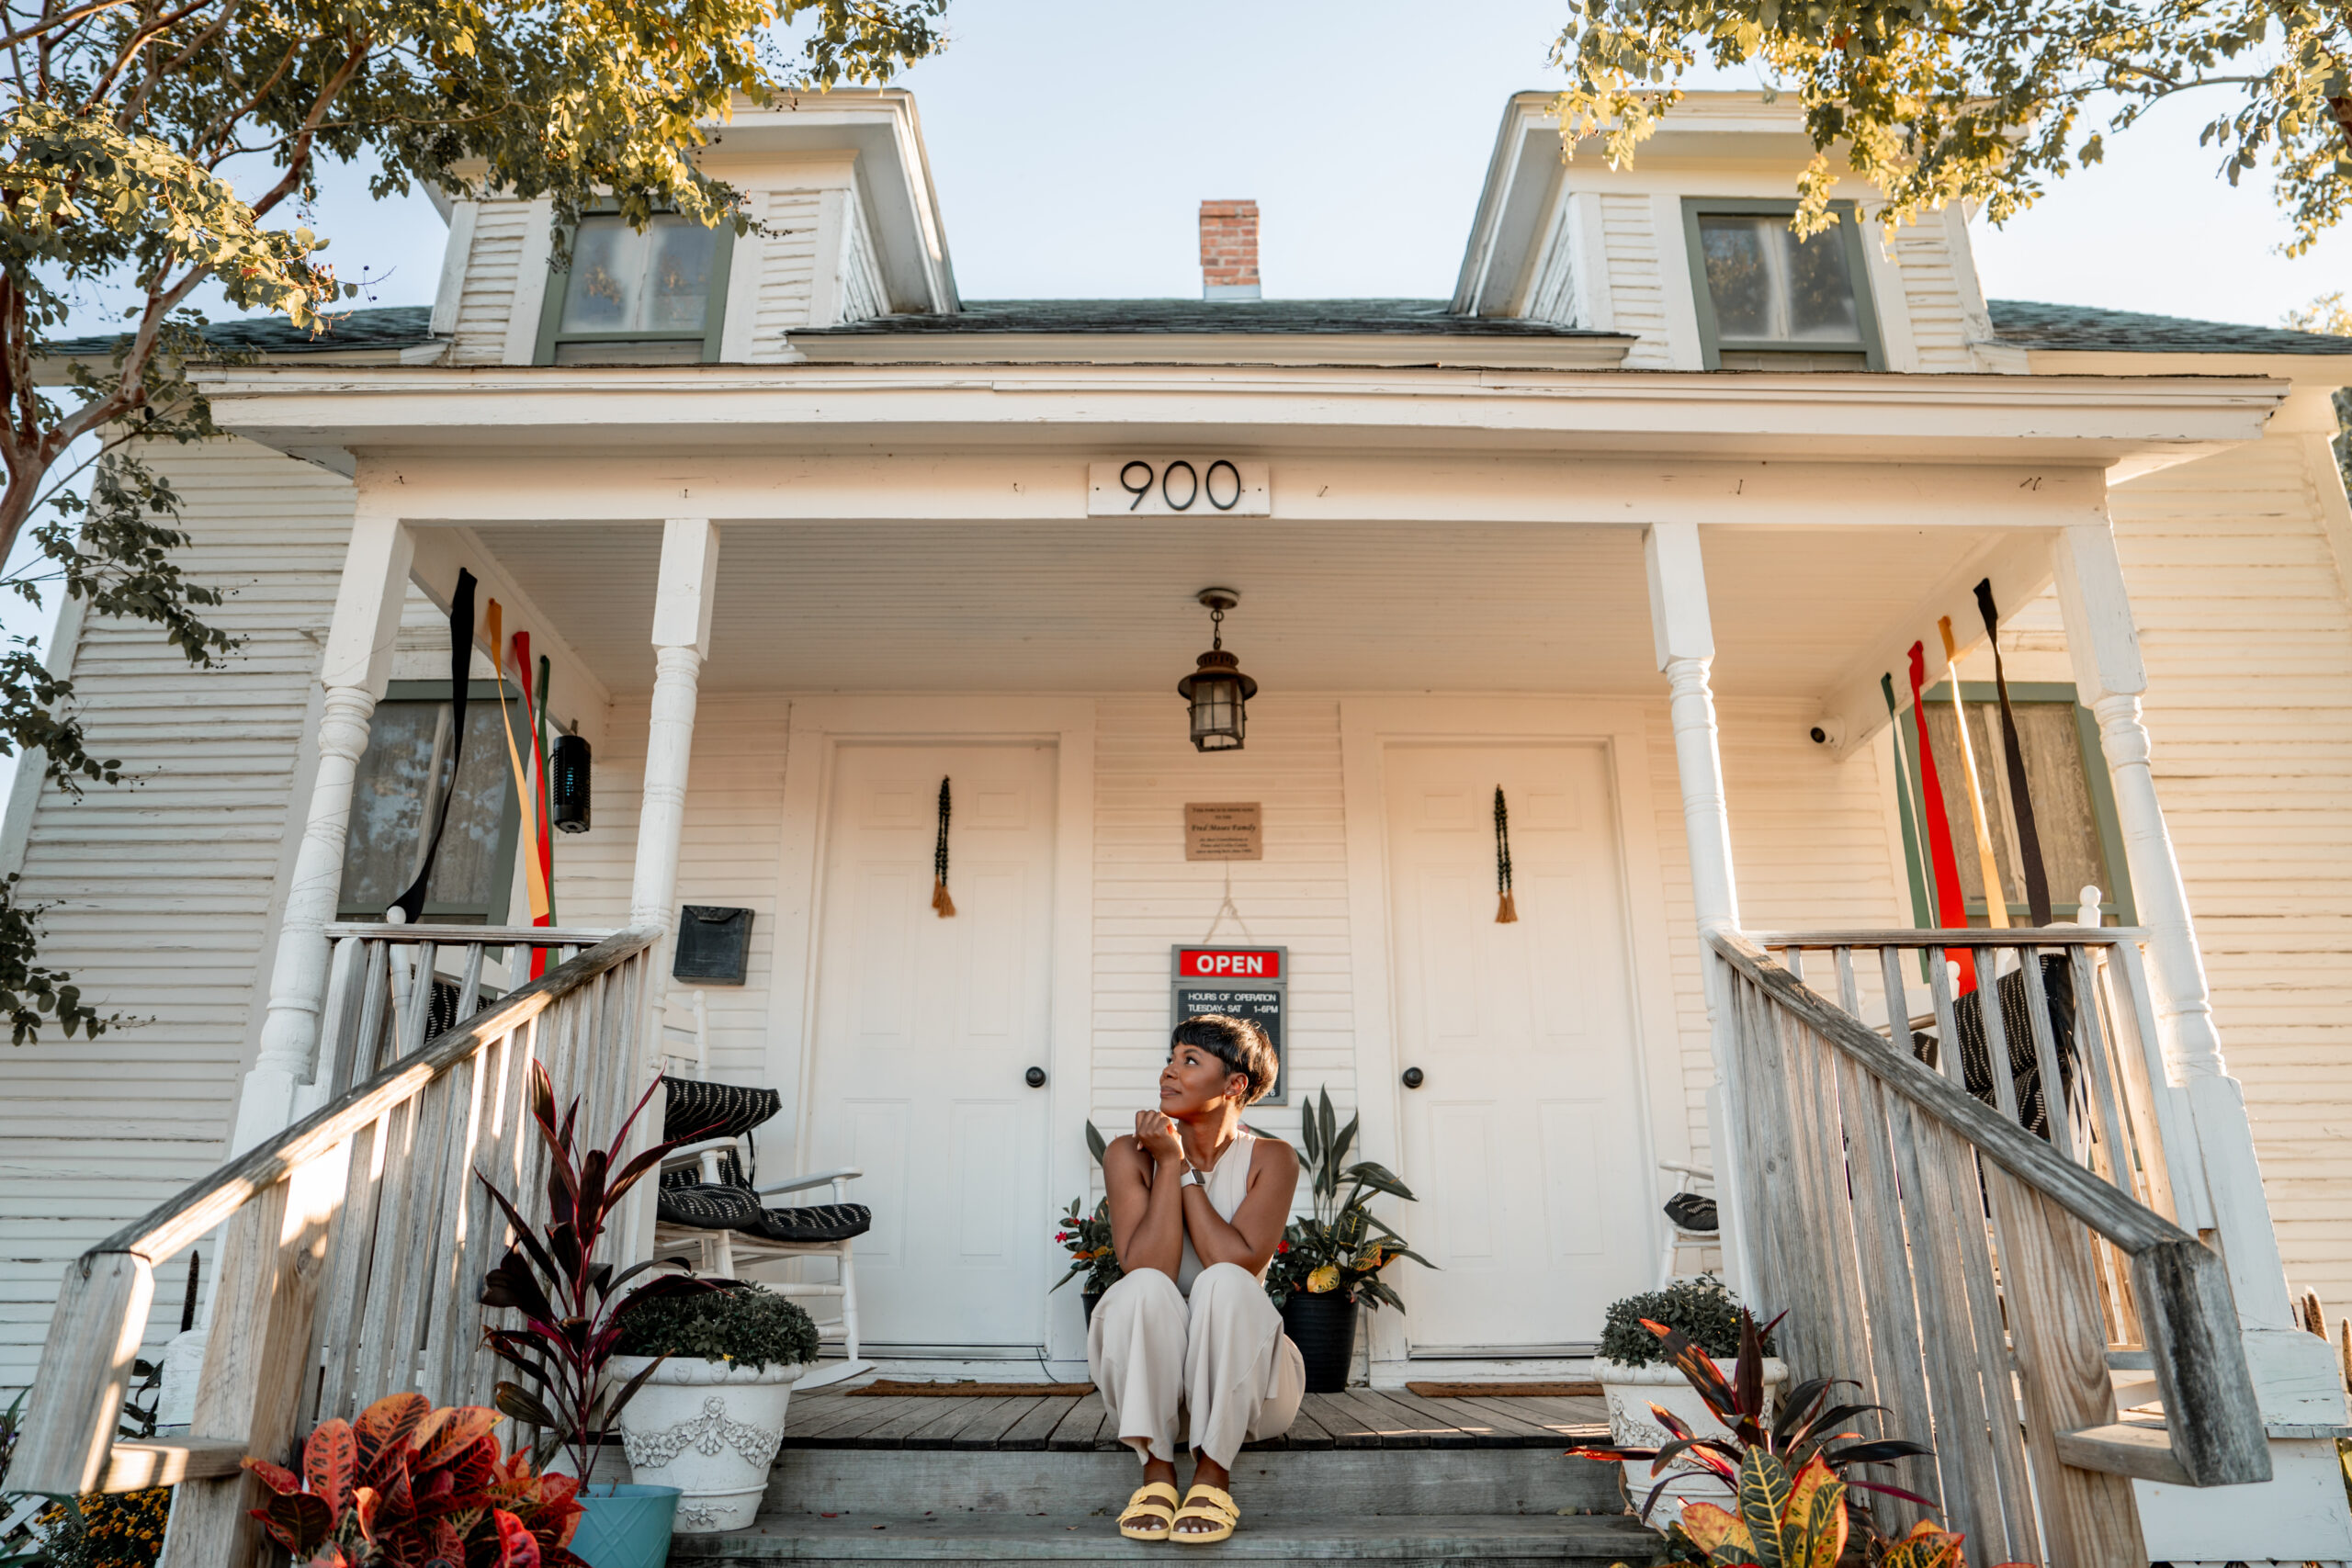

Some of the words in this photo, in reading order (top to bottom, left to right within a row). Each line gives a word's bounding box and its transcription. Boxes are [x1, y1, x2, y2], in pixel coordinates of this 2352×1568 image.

[1120, 459, 1241, 511] 900
[1196, 954, 1263, 974] OPEN
[1188, 993, 1217, 1001] HOURS
[1218, 993, 1231, 1001] OF
[1234, 993, 1276, 1002] OPERATION
[1227, 1004, 1242, 1012] SAT
[1253, 1005, 1279, 1013] 1-6PM
